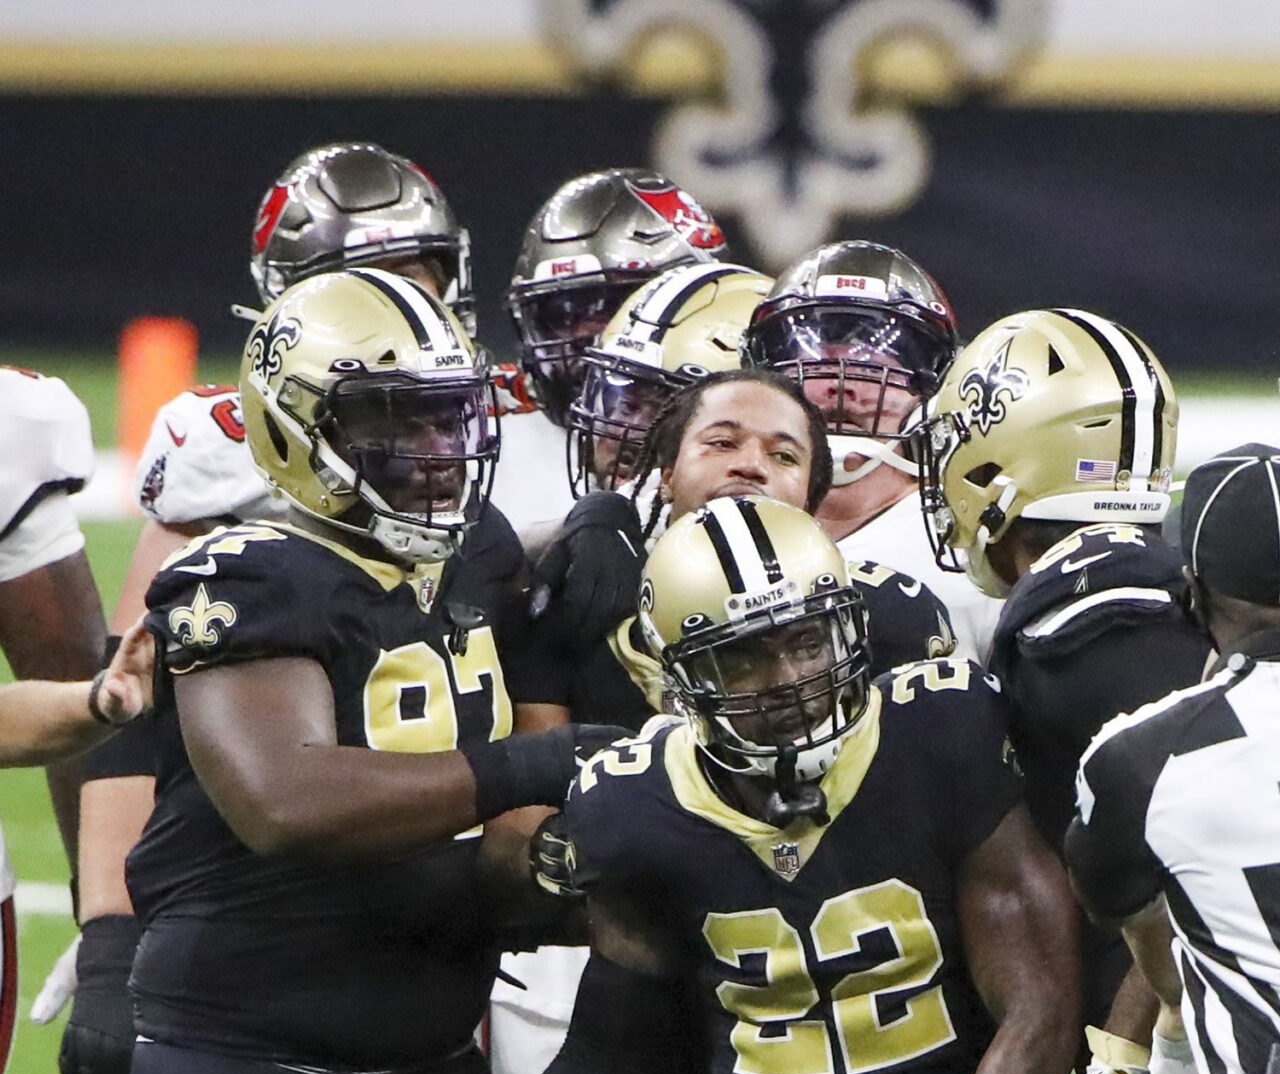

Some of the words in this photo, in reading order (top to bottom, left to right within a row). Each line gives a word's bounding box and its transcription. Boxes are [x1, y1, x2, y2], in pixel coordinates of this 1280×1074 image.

[435, 354, 465, 367] SAINTS
[1094, 502, 1137, 511] BREONNA
[745, 588, 784, 609] SAINTS
[363, 626, 514, 754] 97
